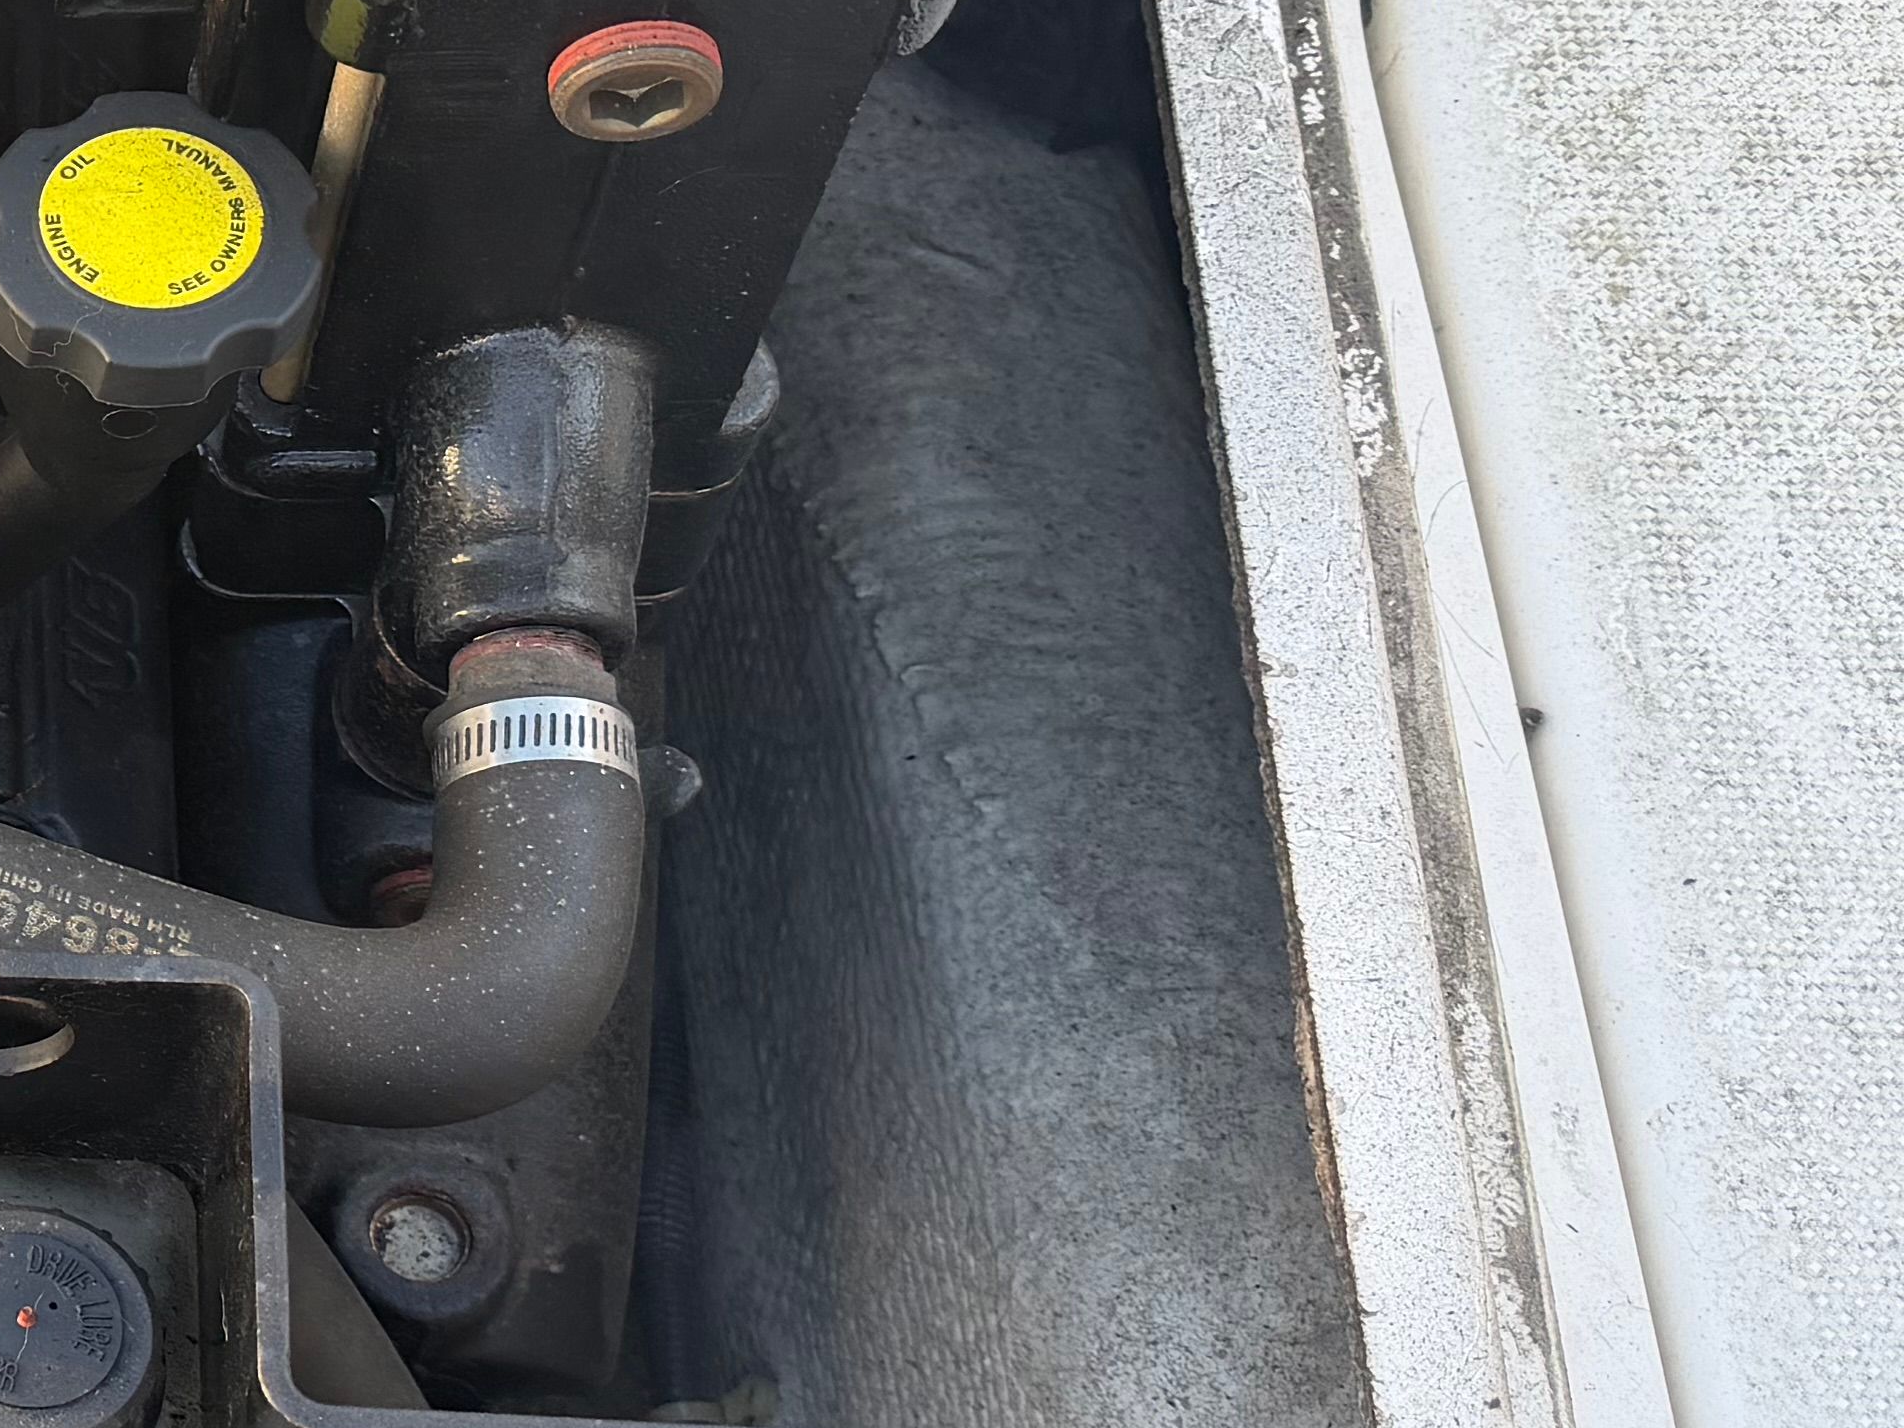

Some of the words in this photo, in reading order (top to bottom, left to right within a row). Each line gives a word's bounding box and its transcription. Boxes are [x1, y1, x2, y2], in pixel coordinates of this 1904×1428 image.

[60, 154, 95, 180] OIL
[162, 138, 237, 192] MANUAL
[45, 213, 100, 283] ENGINE
[210, 197, 246, 272] OWNERS
[168, 271, 211, 295] SEE
[47, 884, 73, 904] IN
[77, 895, 143, 927] MADE
[146, 917, 192, 945] RLH
[26, 1244, 92, 1299] DRIVE
[74, 1300, 113, 1363] LUBE
